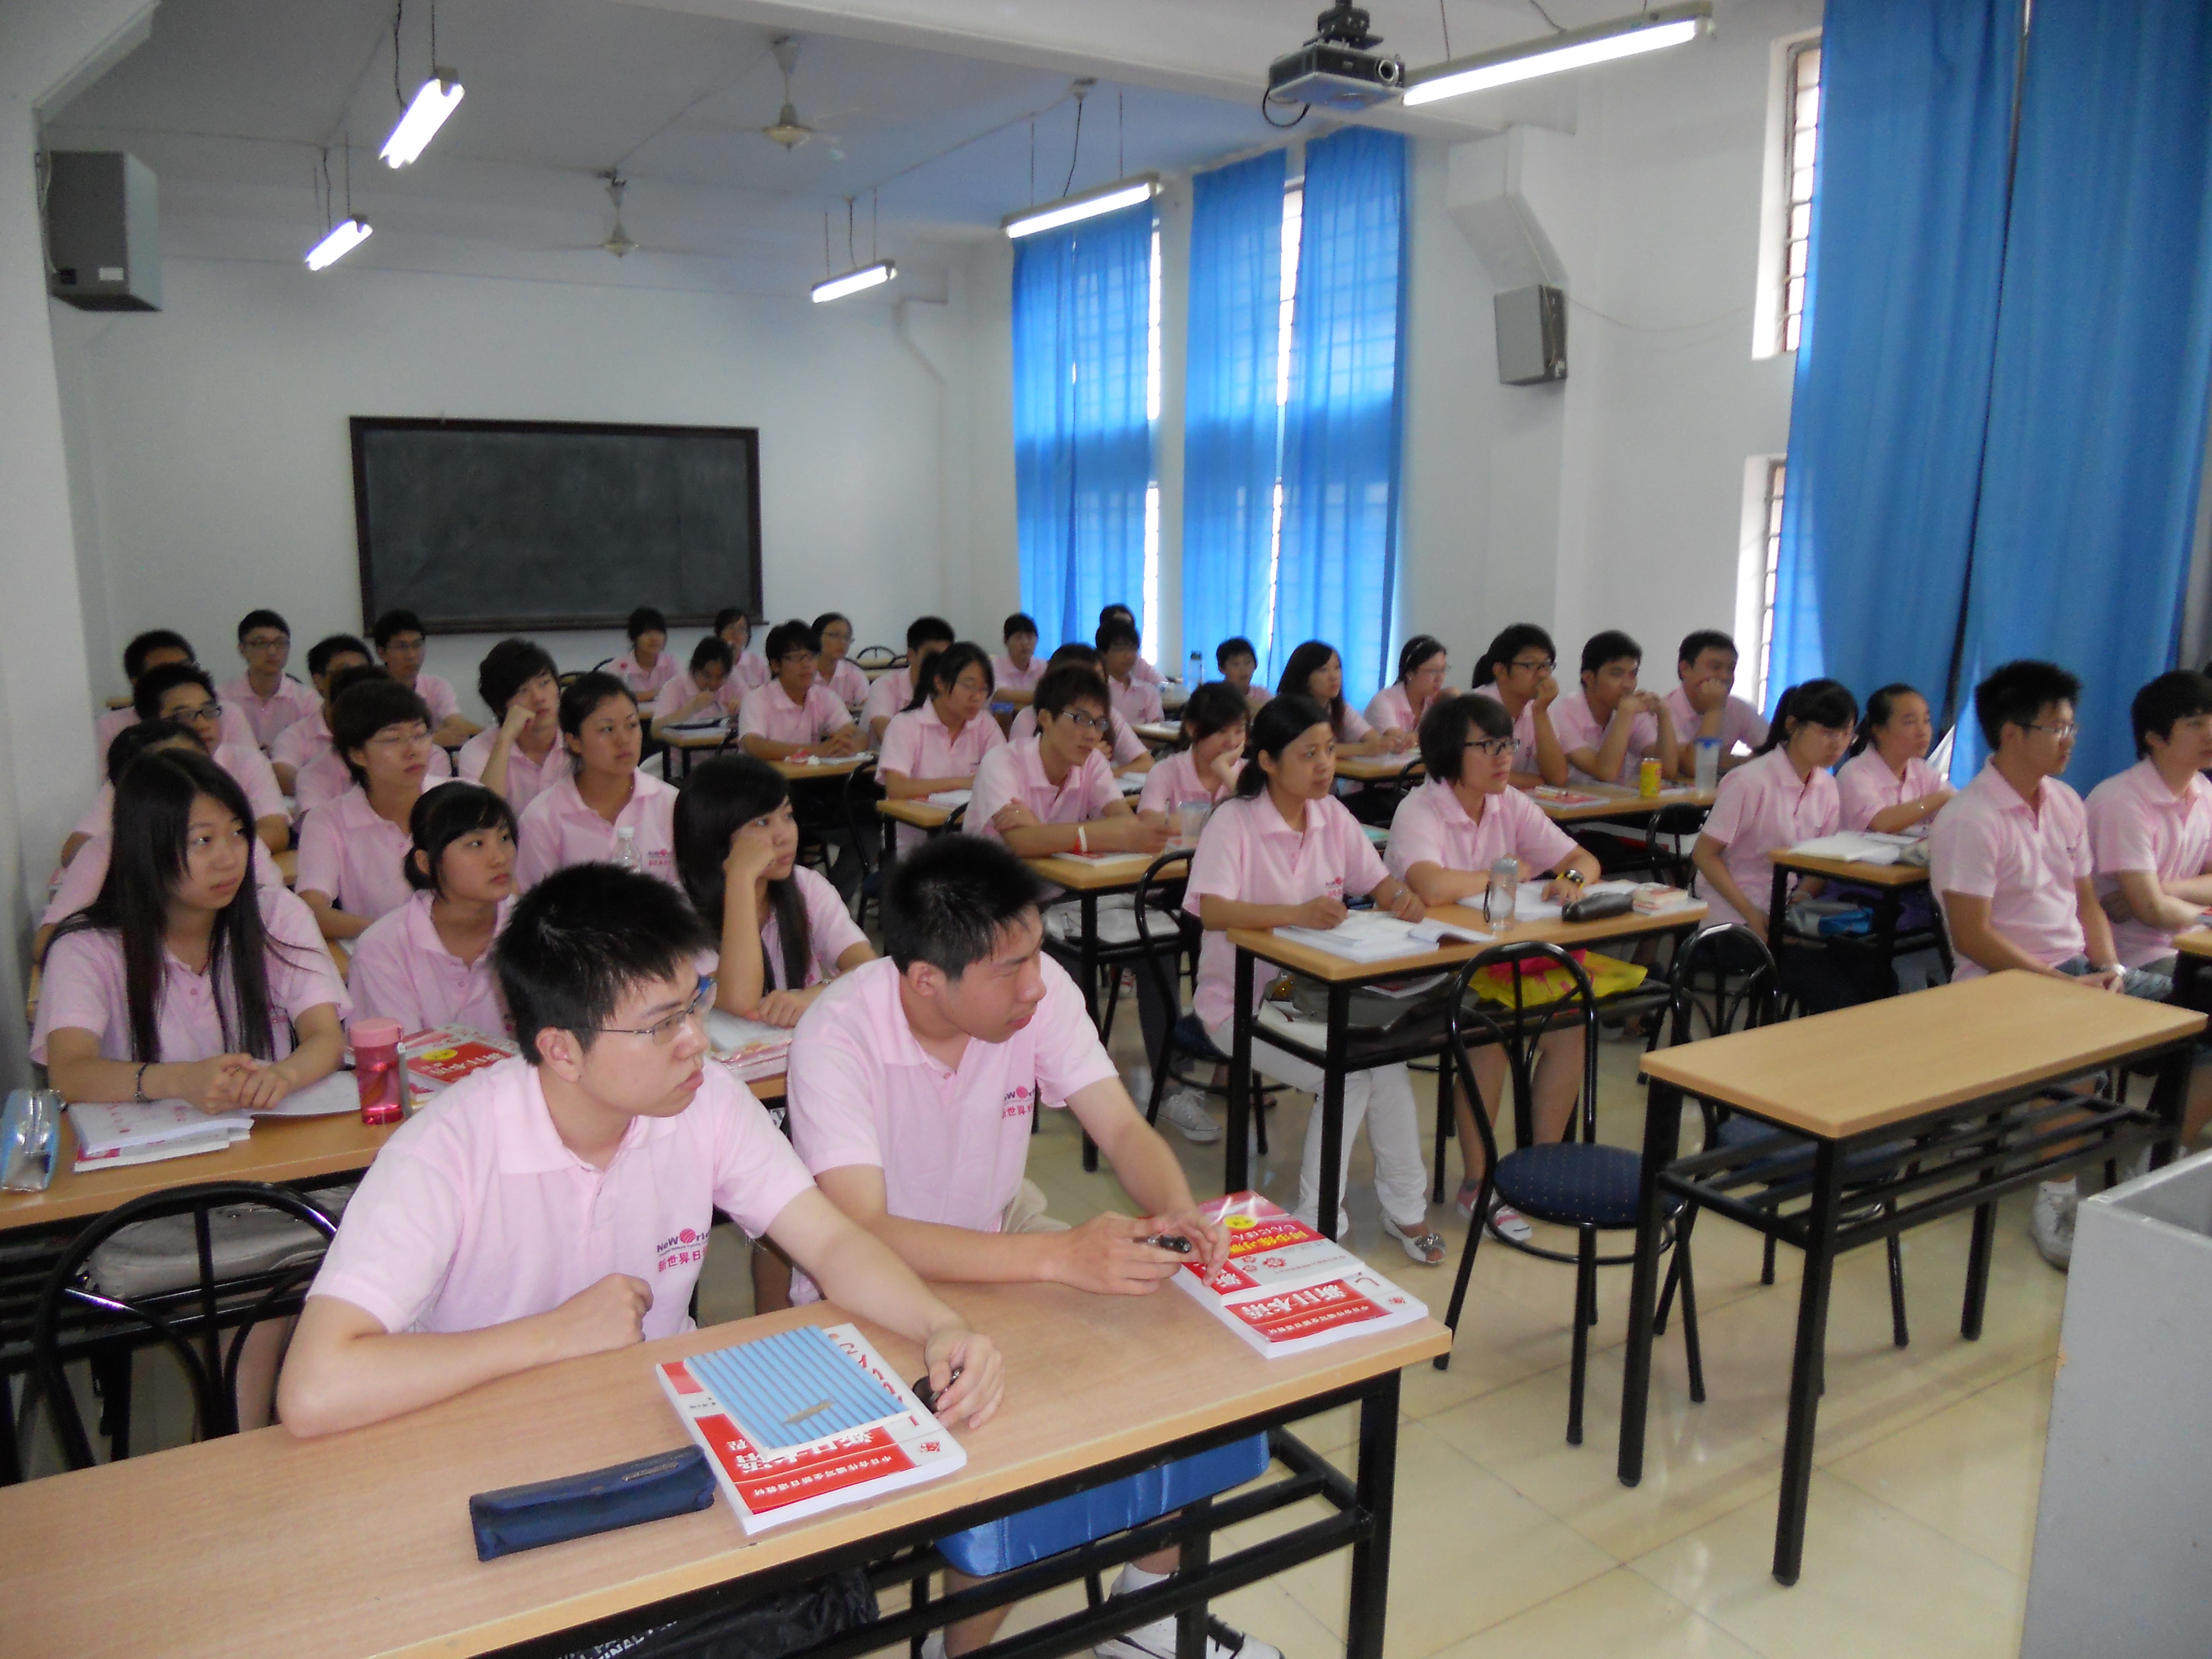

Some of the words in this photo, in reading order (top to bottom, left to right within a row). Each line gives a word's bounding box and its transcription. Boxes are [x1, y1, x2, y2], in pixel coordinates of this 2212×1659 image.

[1241, 1284, 1347, 1319] 新日本语
[754, 1454, 892, 1496] 中日合作编写全新日语教材
